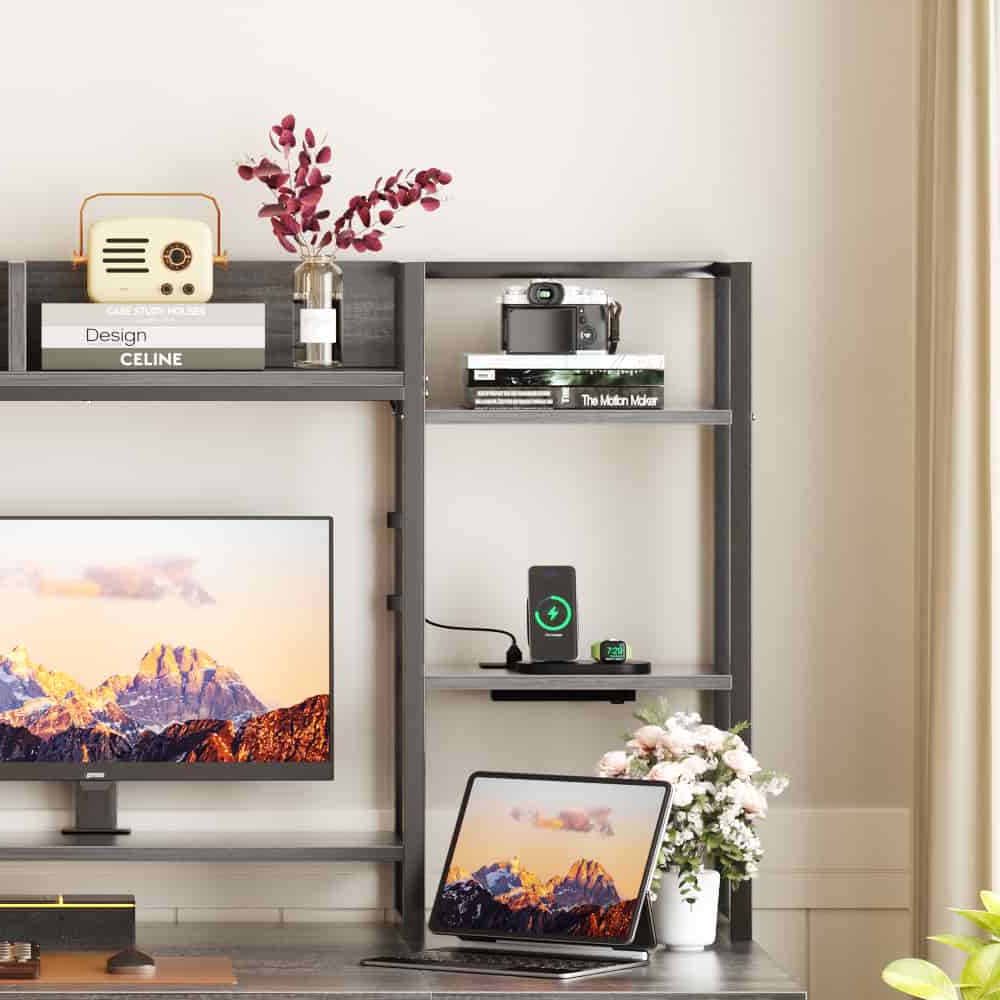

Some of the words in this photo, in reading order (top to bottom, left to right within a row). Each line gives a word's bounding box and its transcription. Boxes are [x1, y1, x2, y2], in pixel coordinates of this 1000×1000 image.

[86, 328, 147, 346] Design
[120, 352, 183, 366] CELINE
[581, 393, 599, 407] The
[600, 393, 629, 407] Motion
[630, 393, 659, 407] Maker
